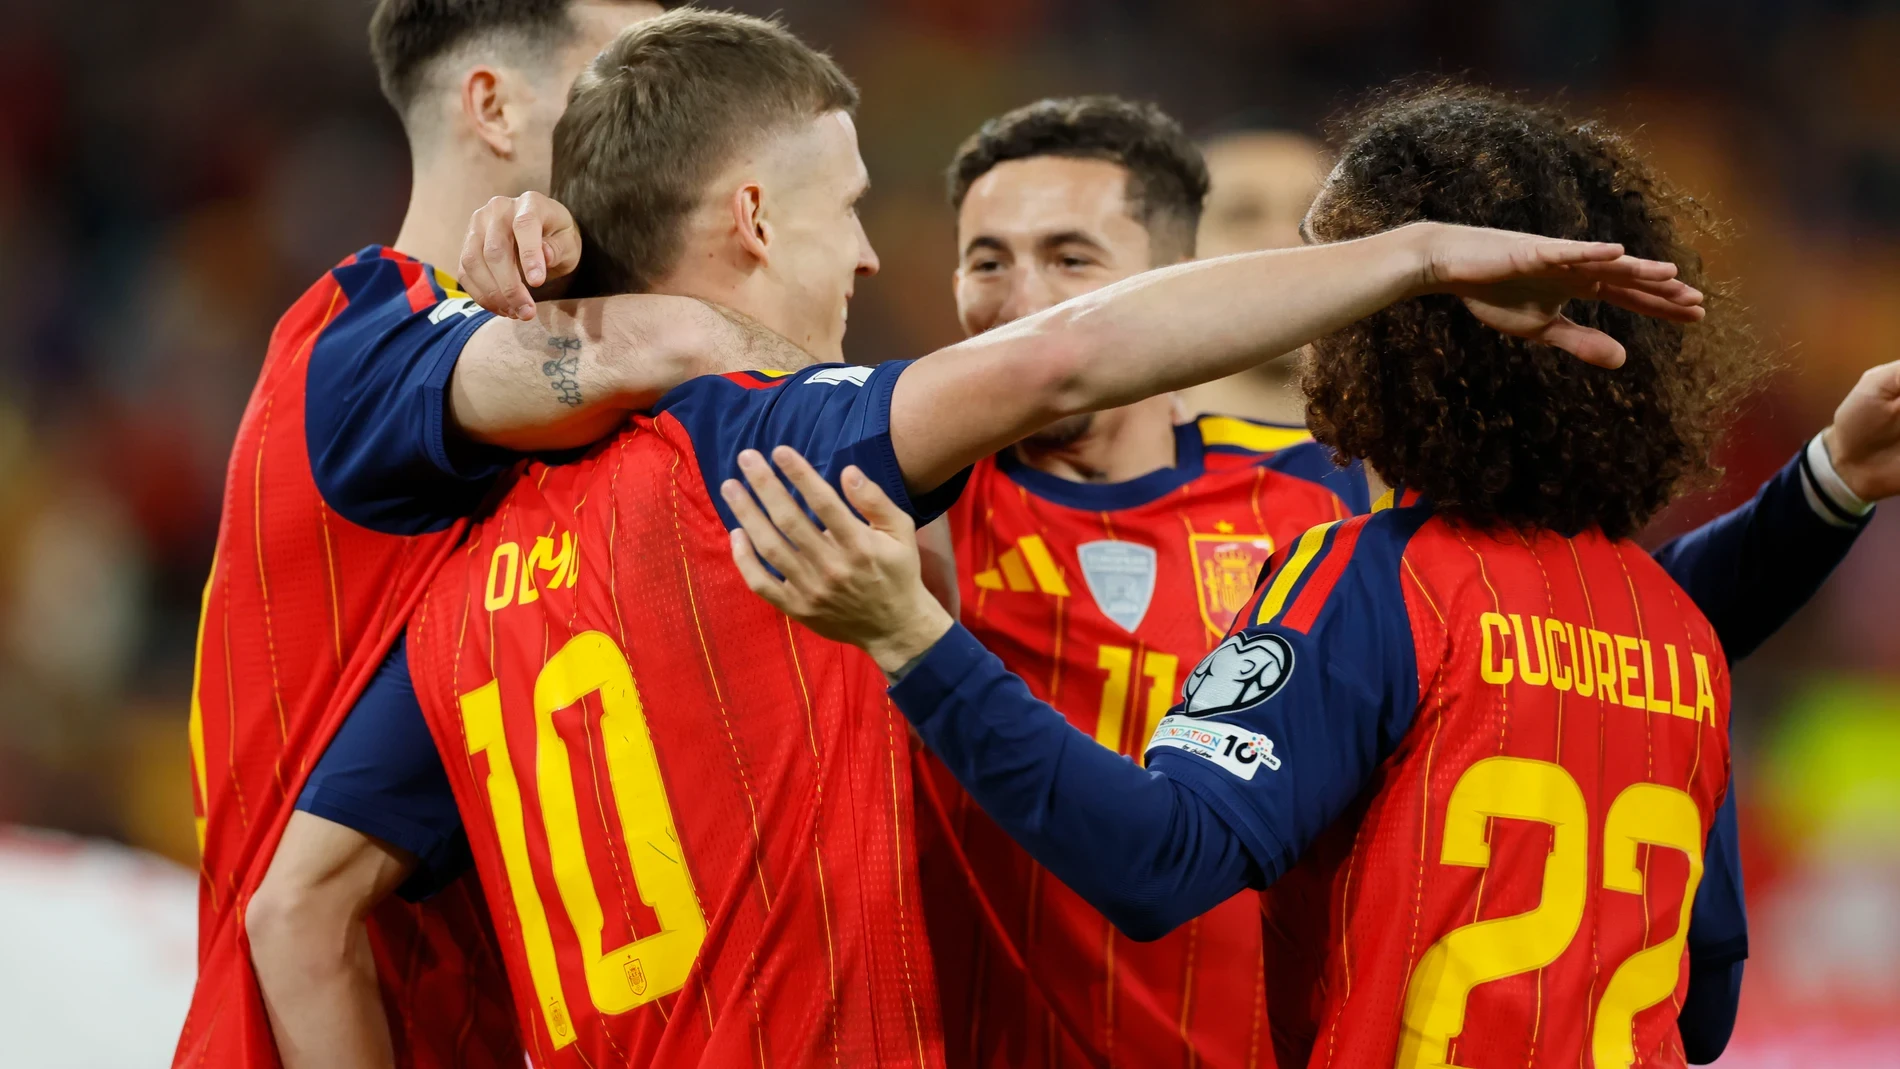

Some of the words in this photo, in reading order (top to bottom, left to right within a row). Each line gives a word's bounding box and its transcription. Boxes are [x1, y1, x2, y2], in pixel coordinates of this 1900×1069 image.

[1096, 645, 1179, 769] 11
[1480, 612, 1716, 728] CUCURELLA
[1152, 727, 1222, 748] FOUNDATION
[1222, 734, 1258, 764] 10
[1259, 752, 1277, 766] YEARS
[459, 630, 707, 1051] 10
[1395, 756, 1704, 1069] 22
